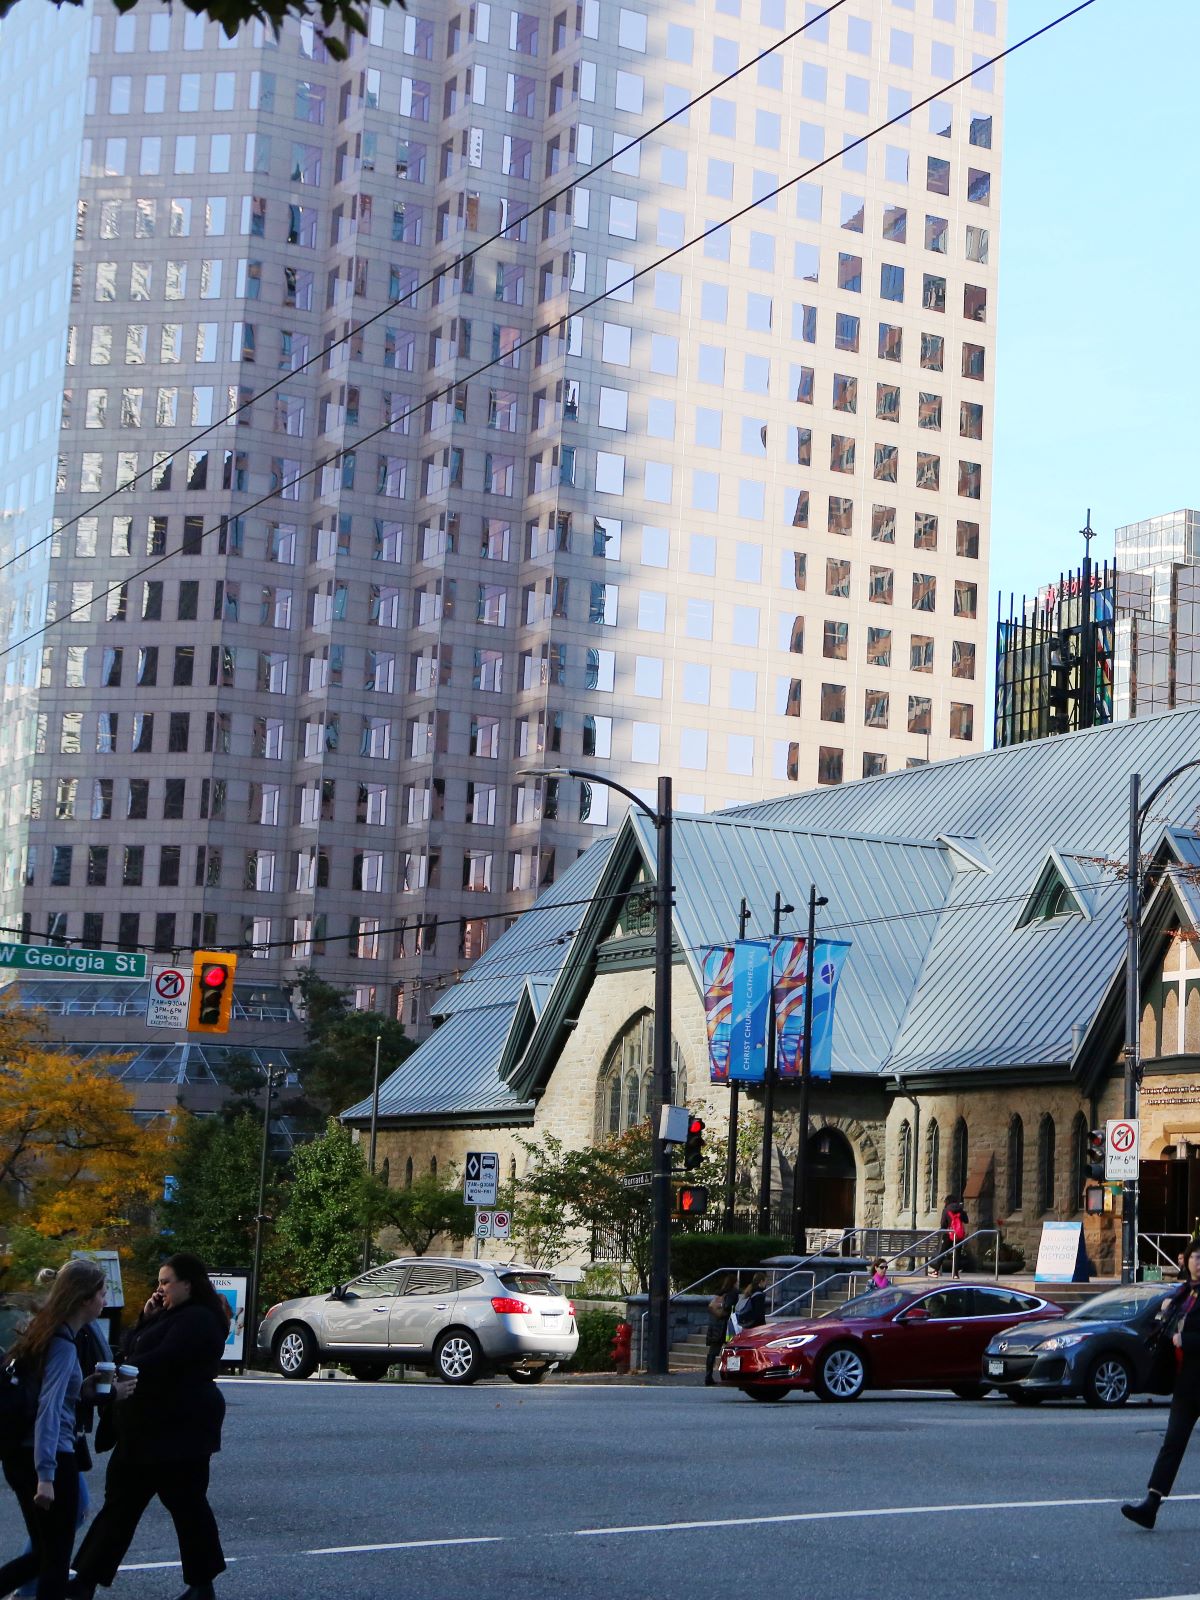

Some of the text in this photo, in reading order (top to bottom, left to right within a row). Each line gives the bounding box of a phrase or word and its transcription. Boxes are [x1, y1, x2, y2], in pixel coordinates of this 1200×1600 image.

[0, 946, 136, 972] W Georgia St
[743, 950, 755, 1071] CHRIST CHURCH CATHEDRAL
